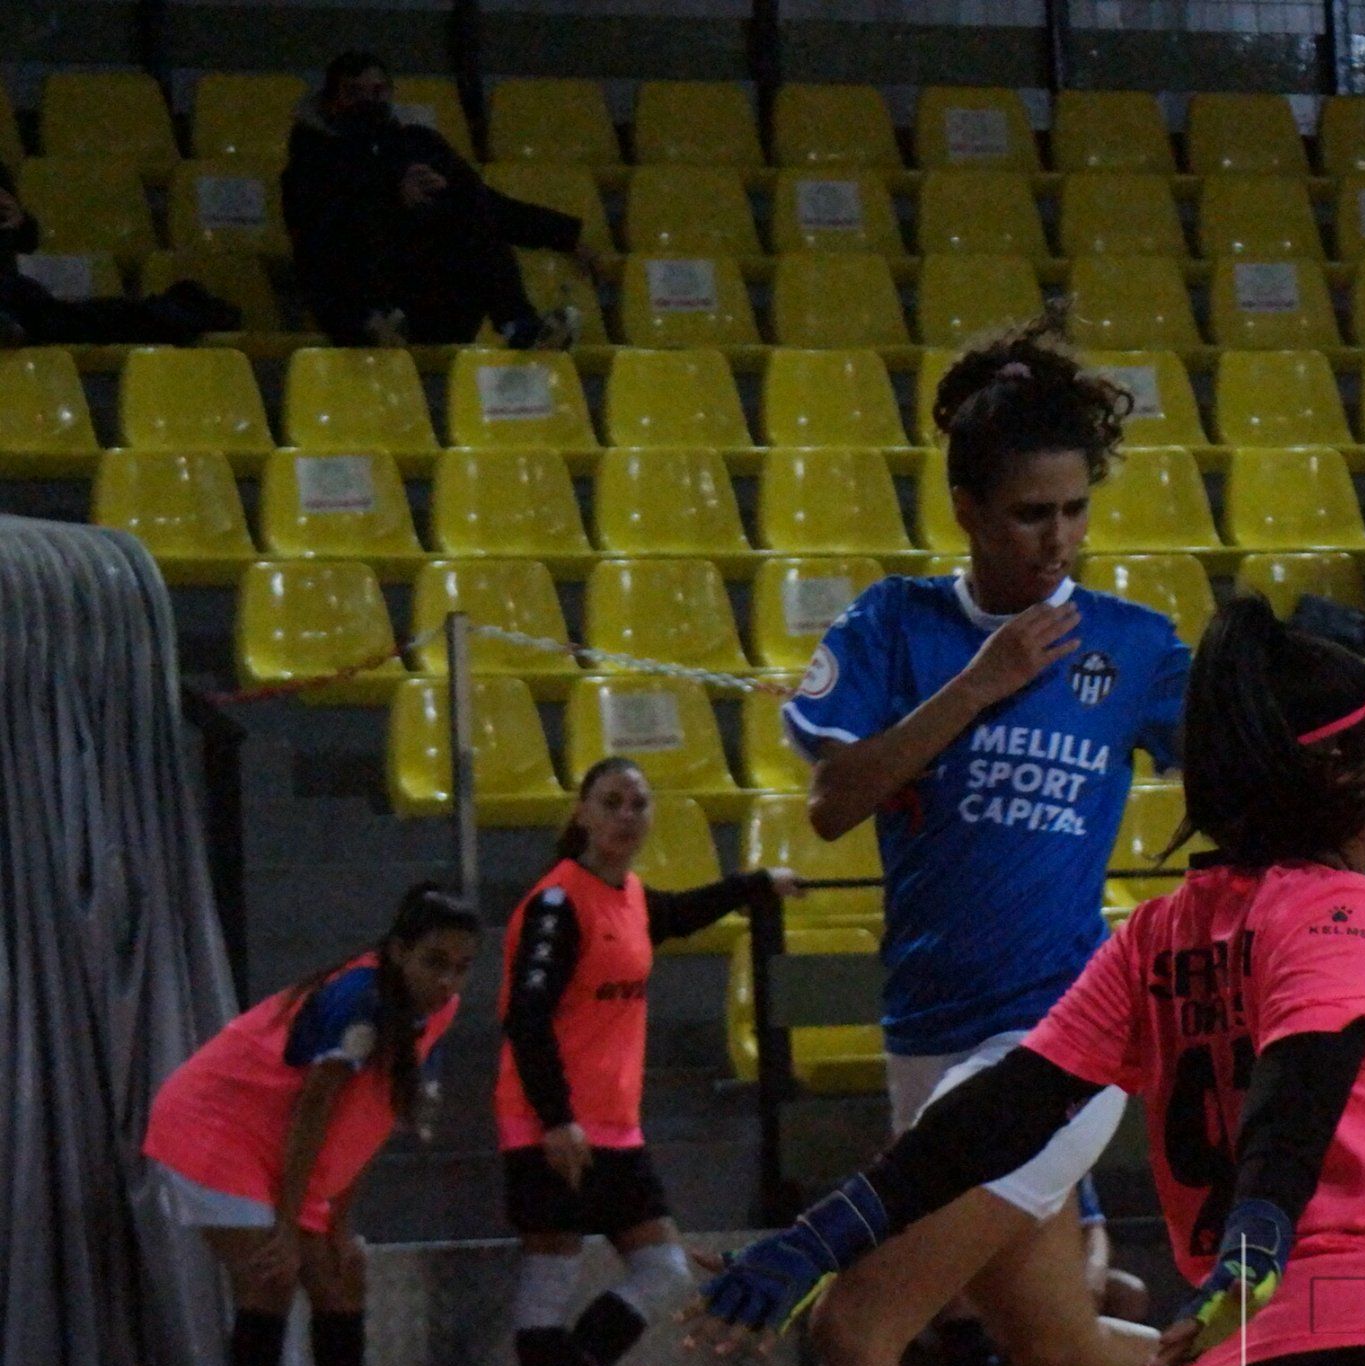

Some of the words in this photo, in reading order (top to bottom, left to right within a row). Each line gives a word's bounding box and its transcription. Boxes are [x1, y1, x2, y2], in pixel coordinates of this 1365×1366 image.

[970, 723, 1110, 775] MELILLA
[967, 758, 1087, 802] SPORT
[957, 793, 1087, 836] CAPITAL
